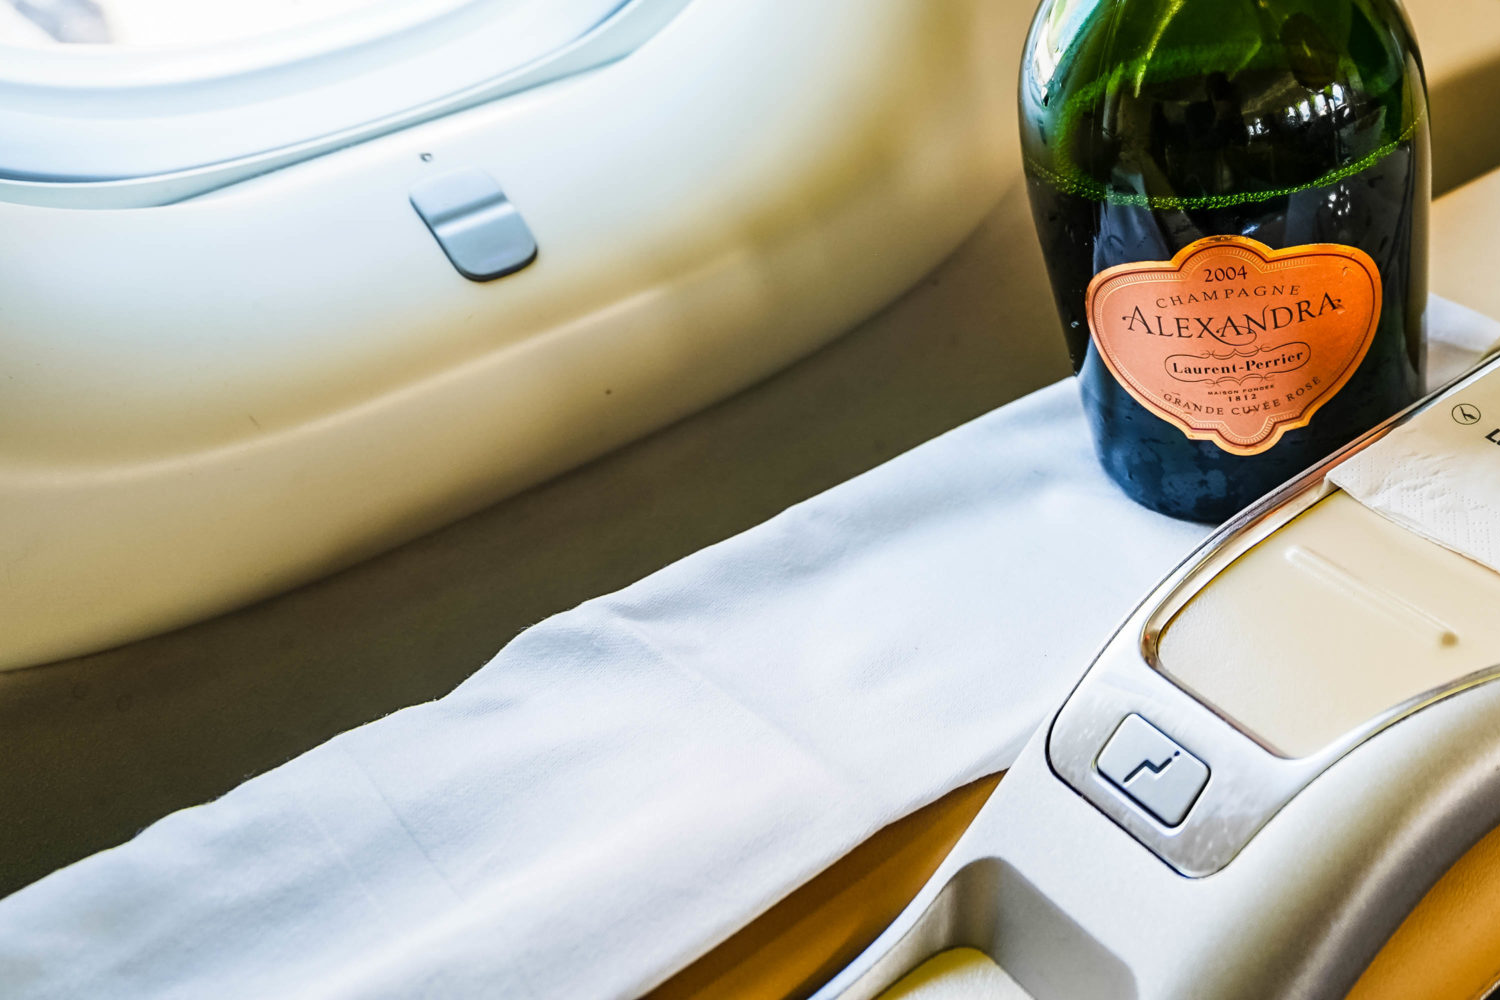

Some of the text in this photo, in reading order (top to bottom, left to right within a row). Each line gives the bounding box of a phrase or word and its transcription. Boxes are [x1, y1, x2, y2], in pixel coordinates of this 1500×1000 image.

[1203, 265, 1248, 283] 2004
[1156, 284, 1301, 309] CHAMPAGNE
[1122, 291, 1342, 346] ALEXANDRA
[1172, 350, 1304, 375] Laurent-Perrier
[1163, 393, 1224, 416] GRANDE
[1231, 399, 1281, 416] CUVÉE
[1228, 393, 1257, 403] 1812
